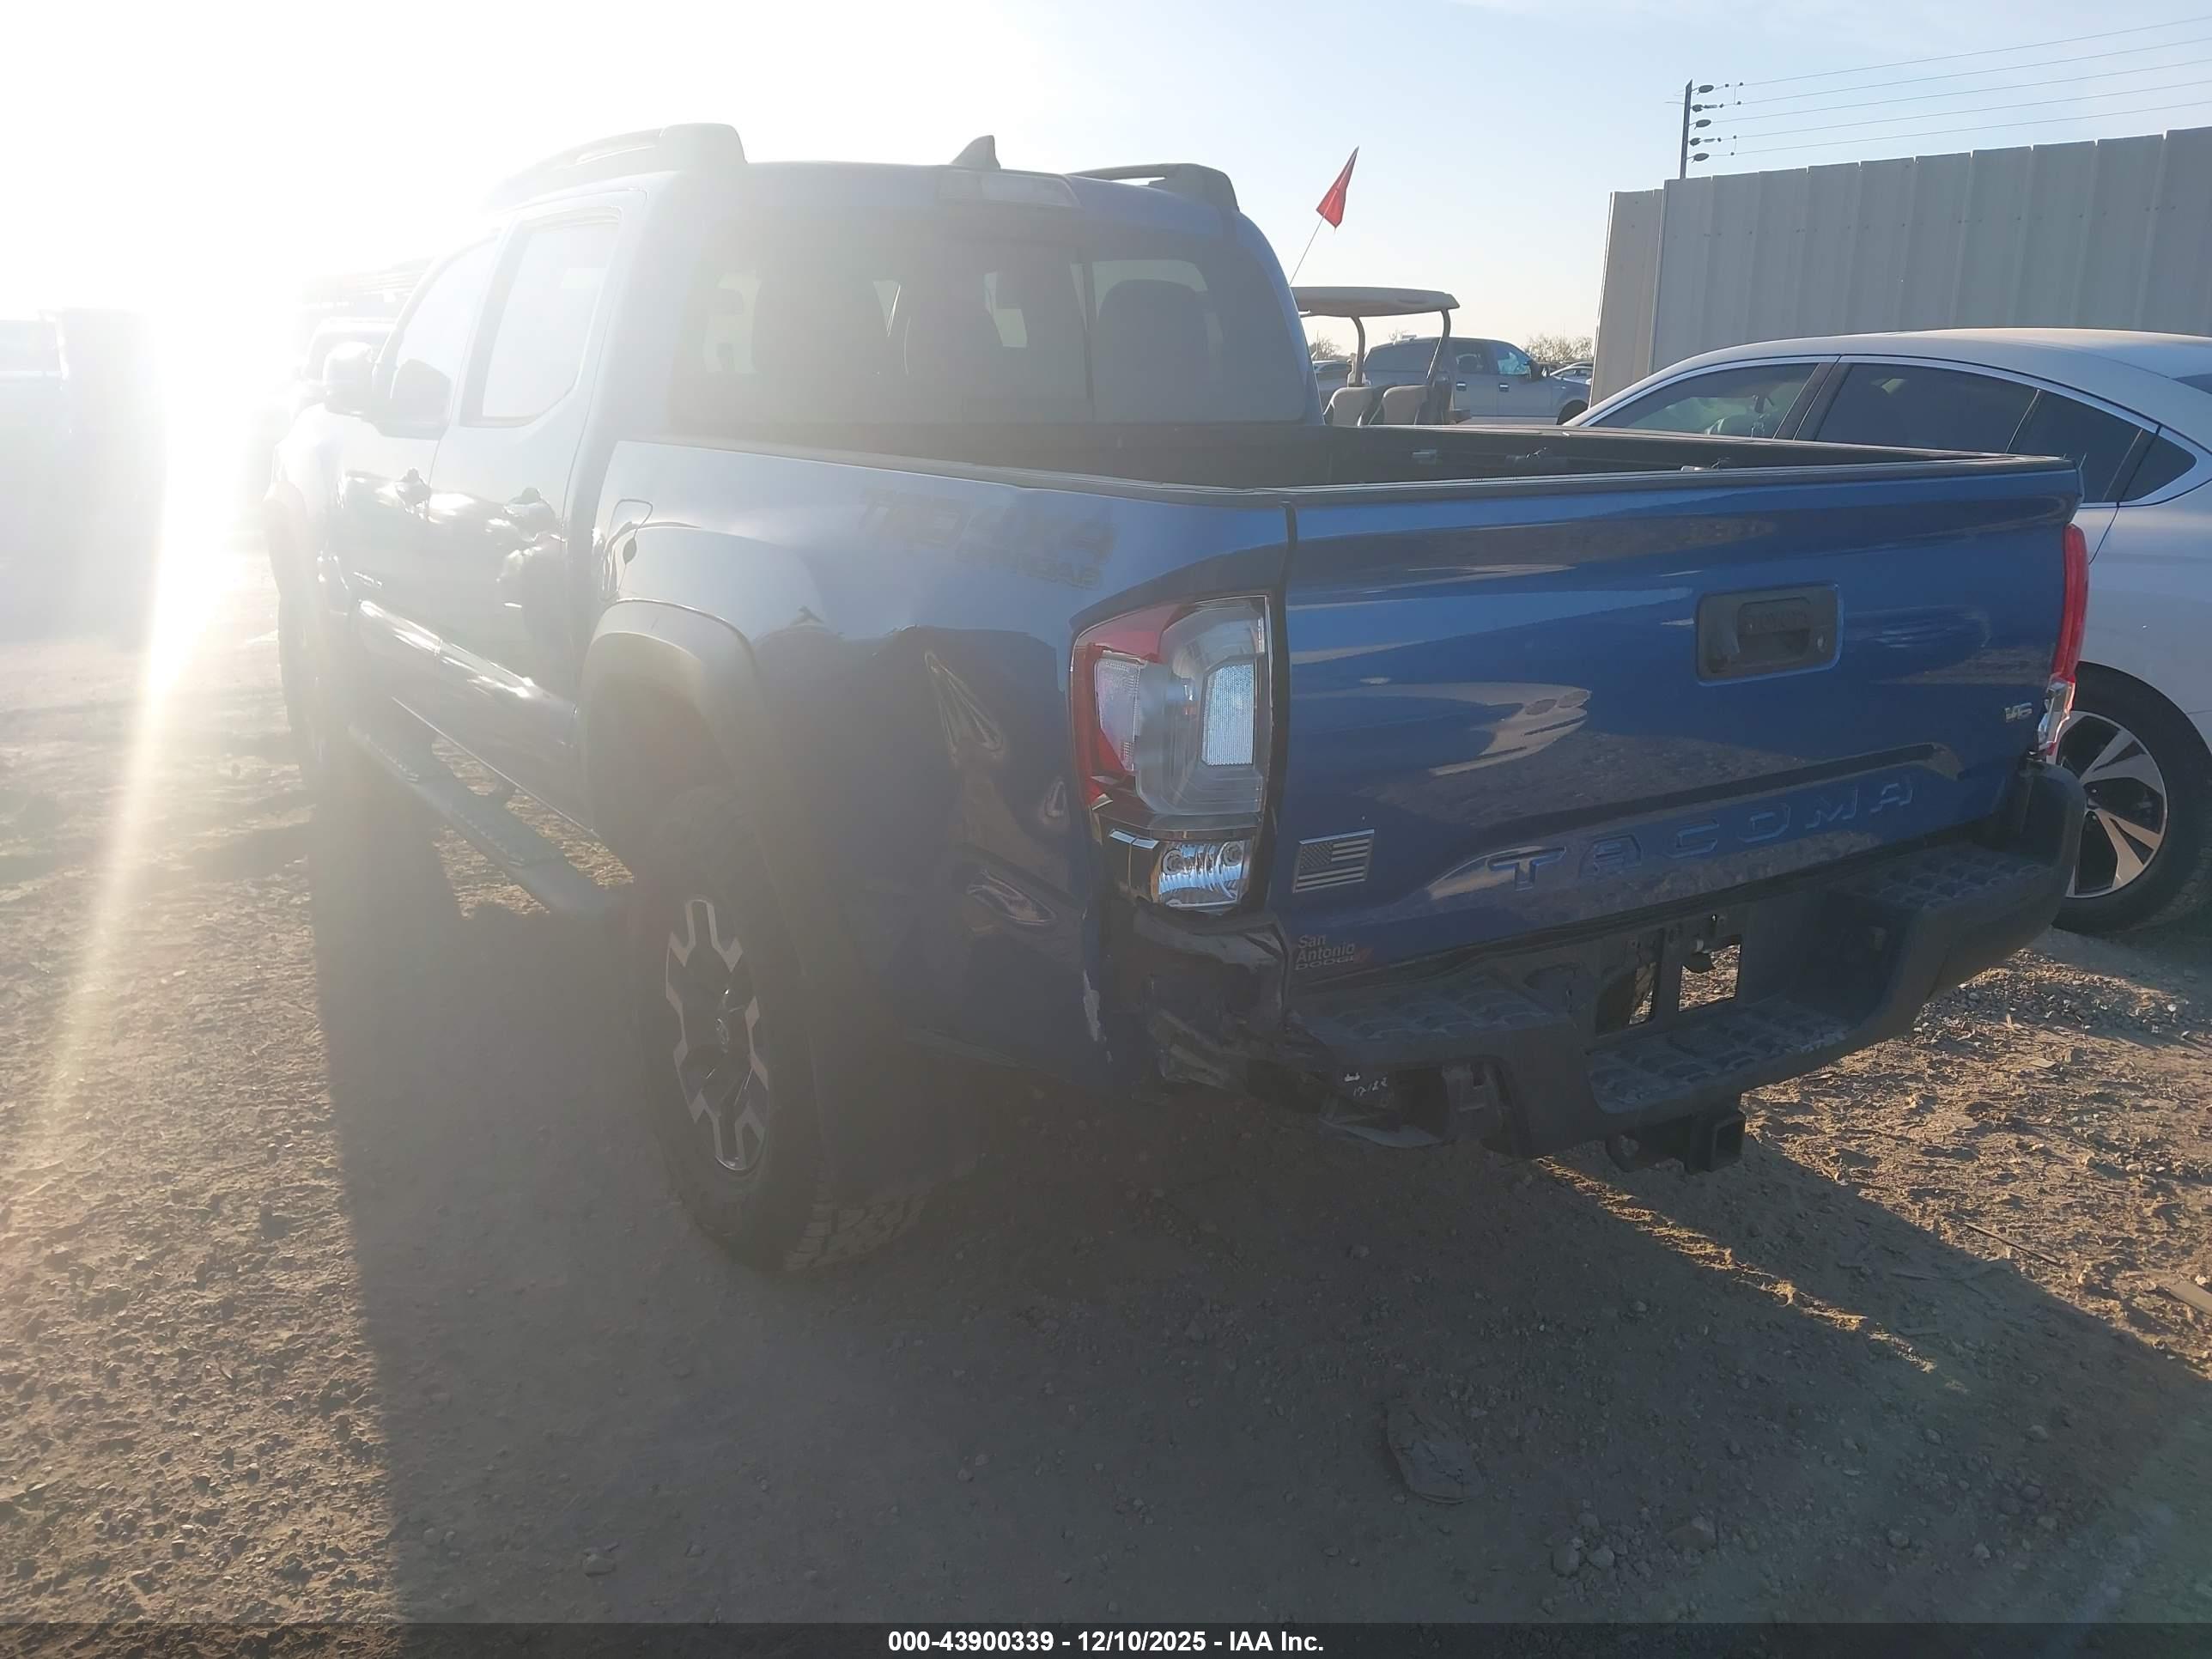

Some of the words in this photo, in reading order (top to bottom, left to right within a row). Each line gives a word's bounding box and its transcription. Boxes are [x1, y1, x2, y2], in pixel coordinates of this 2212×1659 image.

[2004, 702, 2033, 723] V6
[1486, 773, 1914, 892] TACOMA
[1297, 933, 1327, 948] San
[1296, 941, 1354, 963] Antonio
